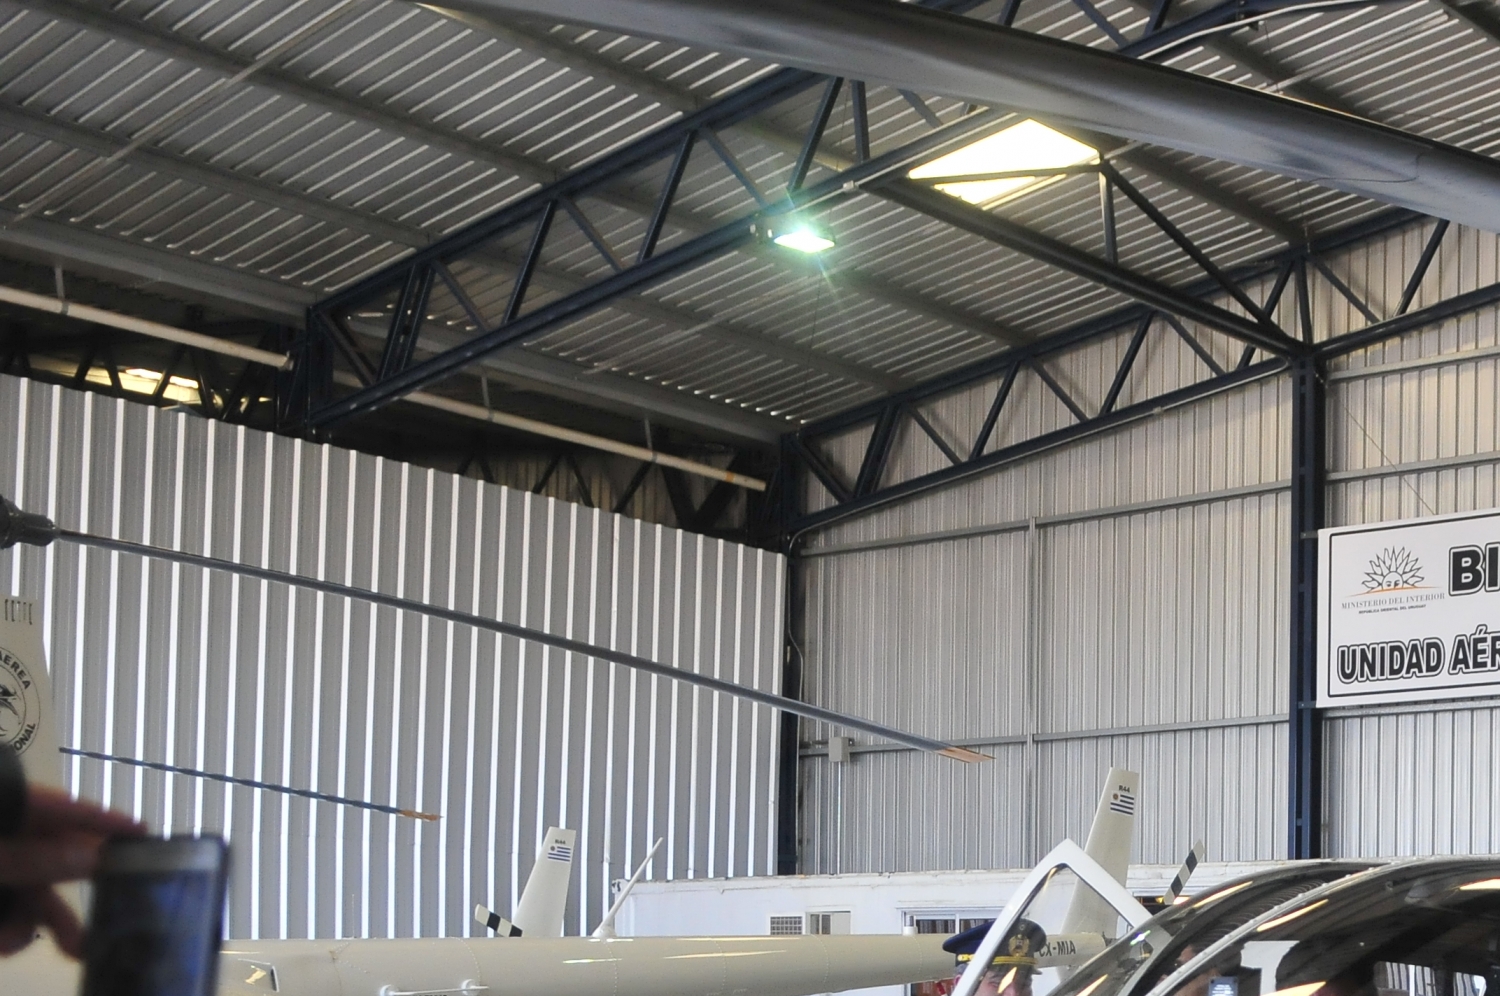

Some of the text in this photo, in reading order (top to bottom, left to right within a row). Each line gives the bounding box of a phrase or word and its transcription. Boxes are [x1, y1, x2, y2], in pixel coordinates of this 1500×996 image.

[1341, 592, 1446, 609] MINISTERIO DEL INTERIOR
[1337, 637, 1445, 684] UNIDAD
[13, 723, 36, 751] ONAL
